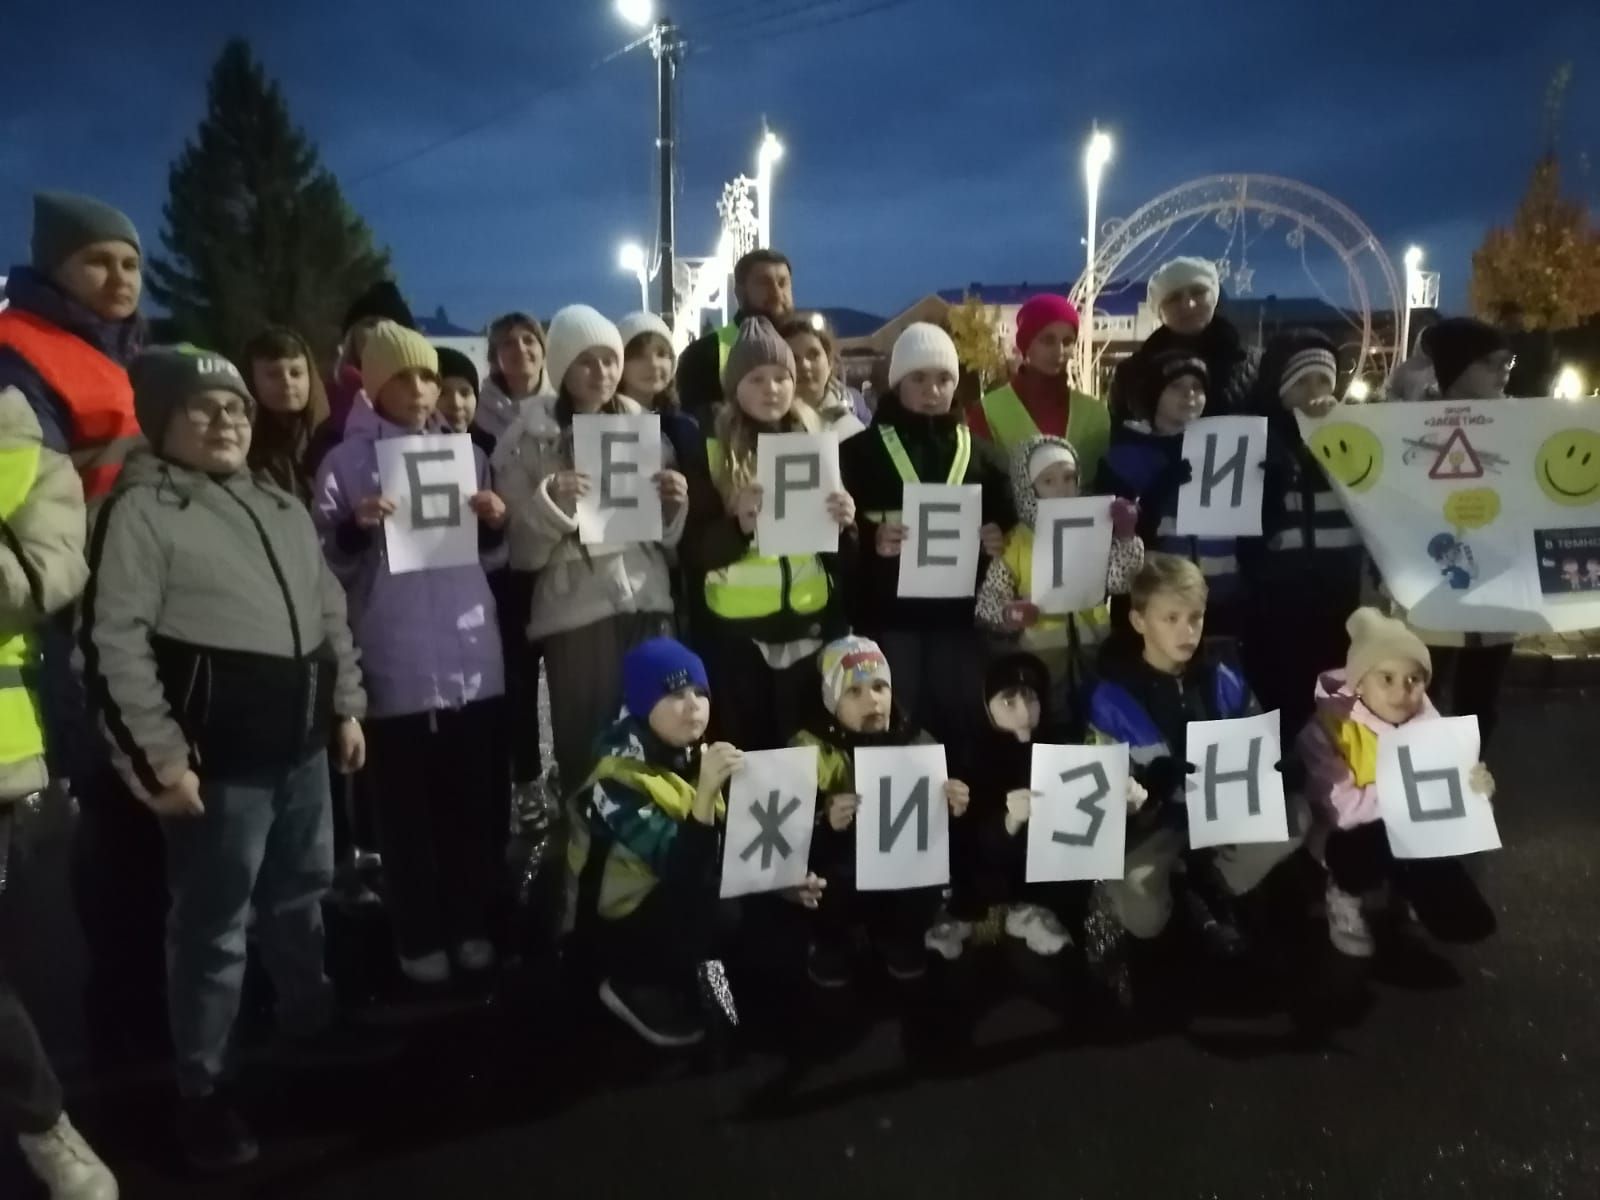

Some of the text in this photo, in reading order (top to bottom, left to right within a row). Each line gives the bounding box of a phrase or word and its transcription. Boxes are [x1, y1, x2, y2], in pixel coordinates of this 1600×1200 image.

[402, 450, 461, 529] Б
[600, 432, 639, 509] Е
[775, 453, 820, 520] Р
[1200, 434, 1248, 507] И
[917, 503, 961, 567] Е
[1053, 517, 1094, 588] Г
[879, 777, 929, 853] И
[1052, 762, 1110, 847] З
[1205, 737, 1261, 822] Н
[1398, 746, 1466, 822] Ь
[740, 790, 801, 870] Ж
